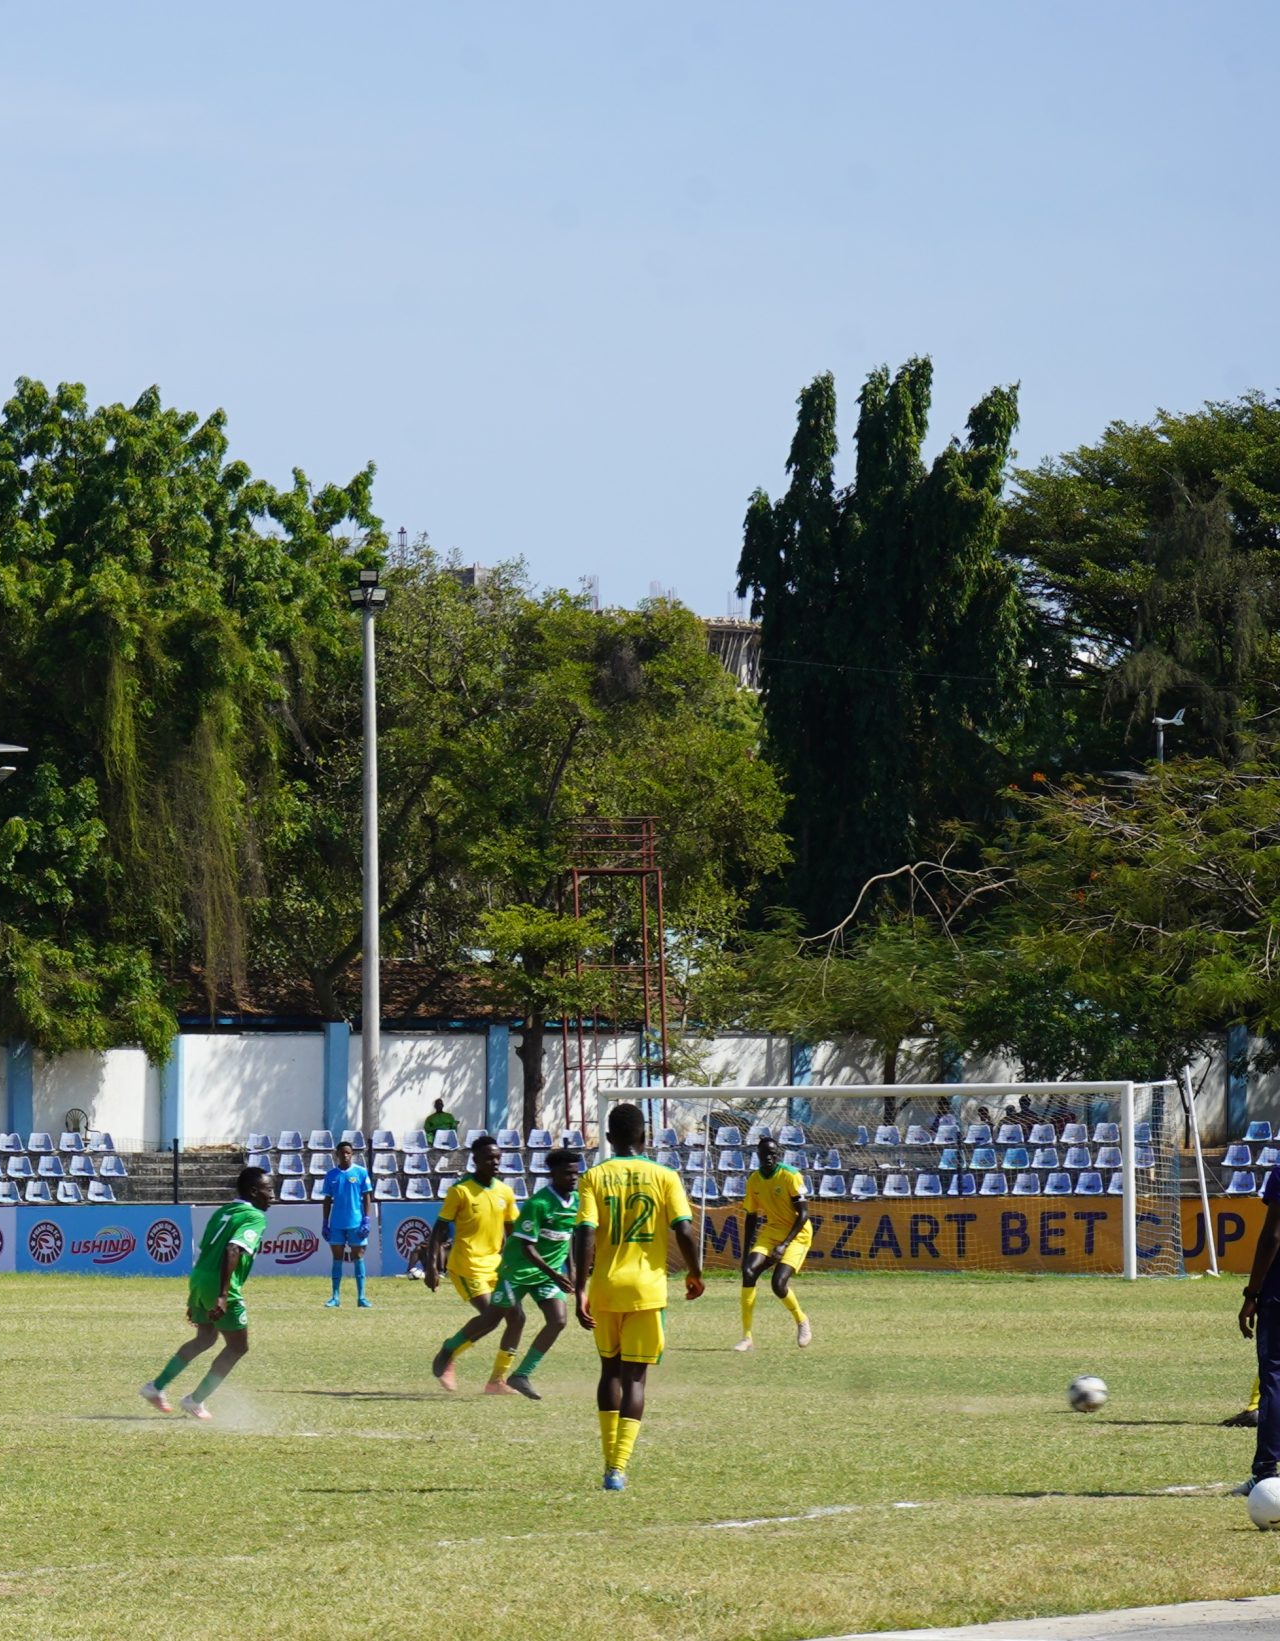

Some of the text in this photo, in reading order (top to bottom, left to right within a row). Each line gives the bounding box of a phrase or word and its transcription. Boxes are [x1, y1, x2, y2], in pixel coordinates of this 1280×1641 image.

[210, 1214, 233, 1245] 7
[603, 1192, 656, 1245] 12
[1000, 1210, 1107, 1256] BET
[71, 1239, 136, 1254] USHINDI
